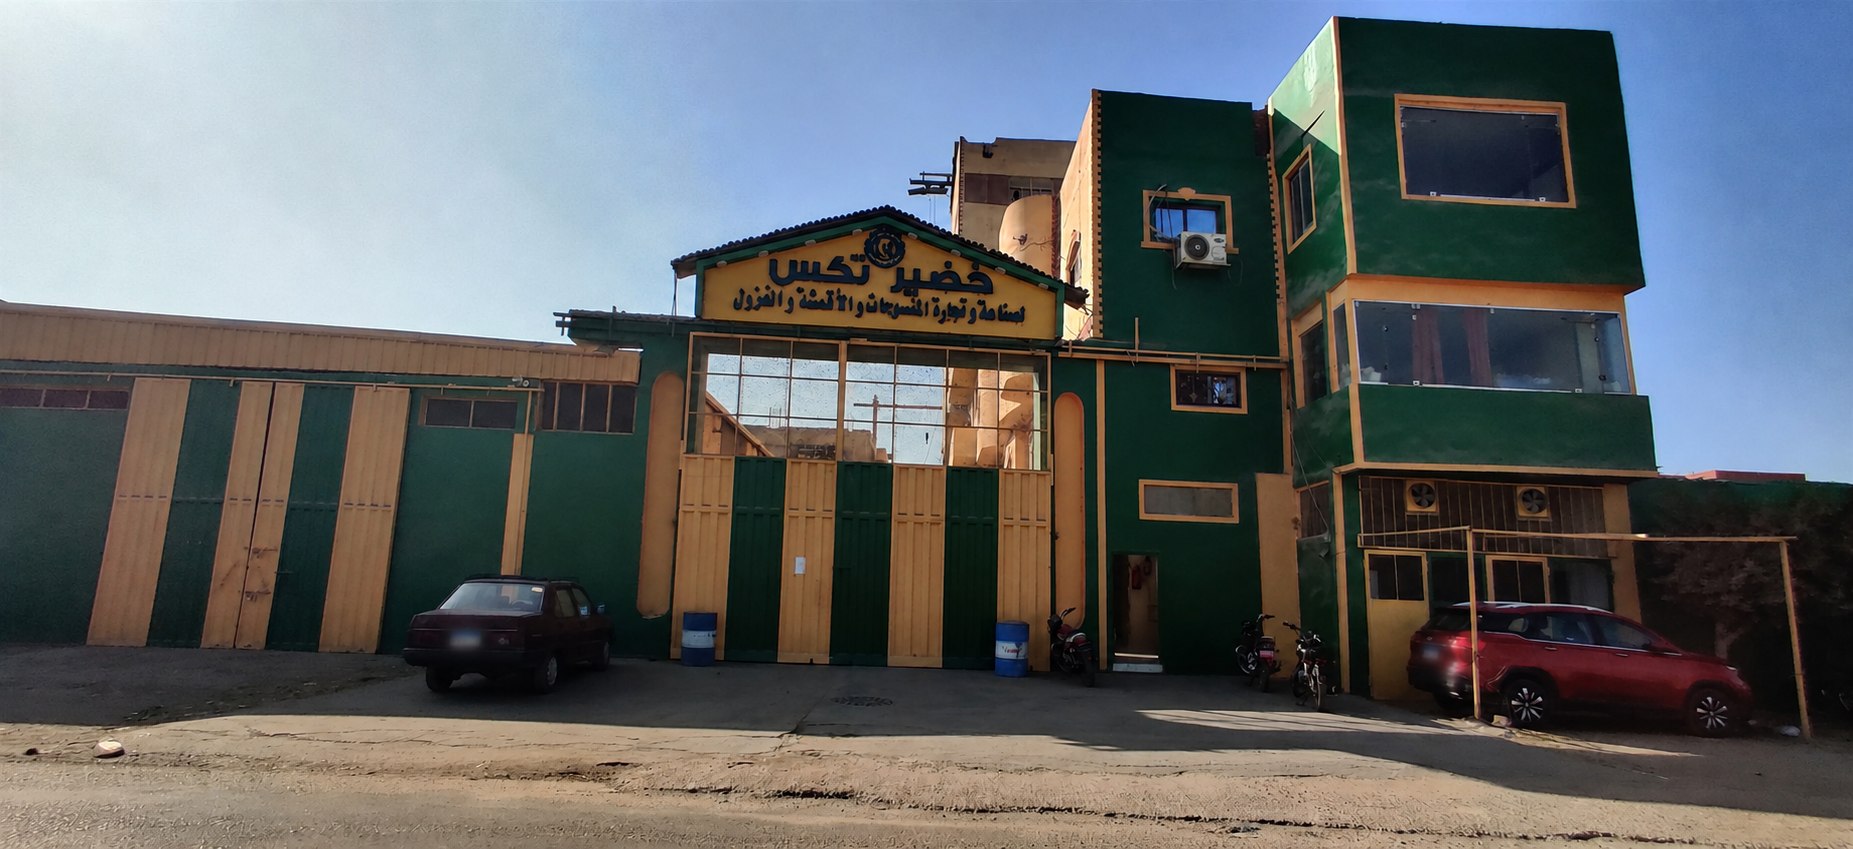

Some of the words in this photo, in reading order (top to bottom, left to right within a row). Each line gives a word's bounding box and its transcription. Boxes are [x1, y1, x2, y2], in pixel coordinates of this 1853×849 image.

[768, 253, 870, 287] تكس
[891, 259, 994, 297] خضير
[733, 284, 783, 311] الغزول
[784, 295, 794, 314] و
[854, 300, 864, 318] و
[866, 291, 929, 320] المنسوجات
[932, 296, 967, 324] تجارة
[967, 306, 977, 324] و
